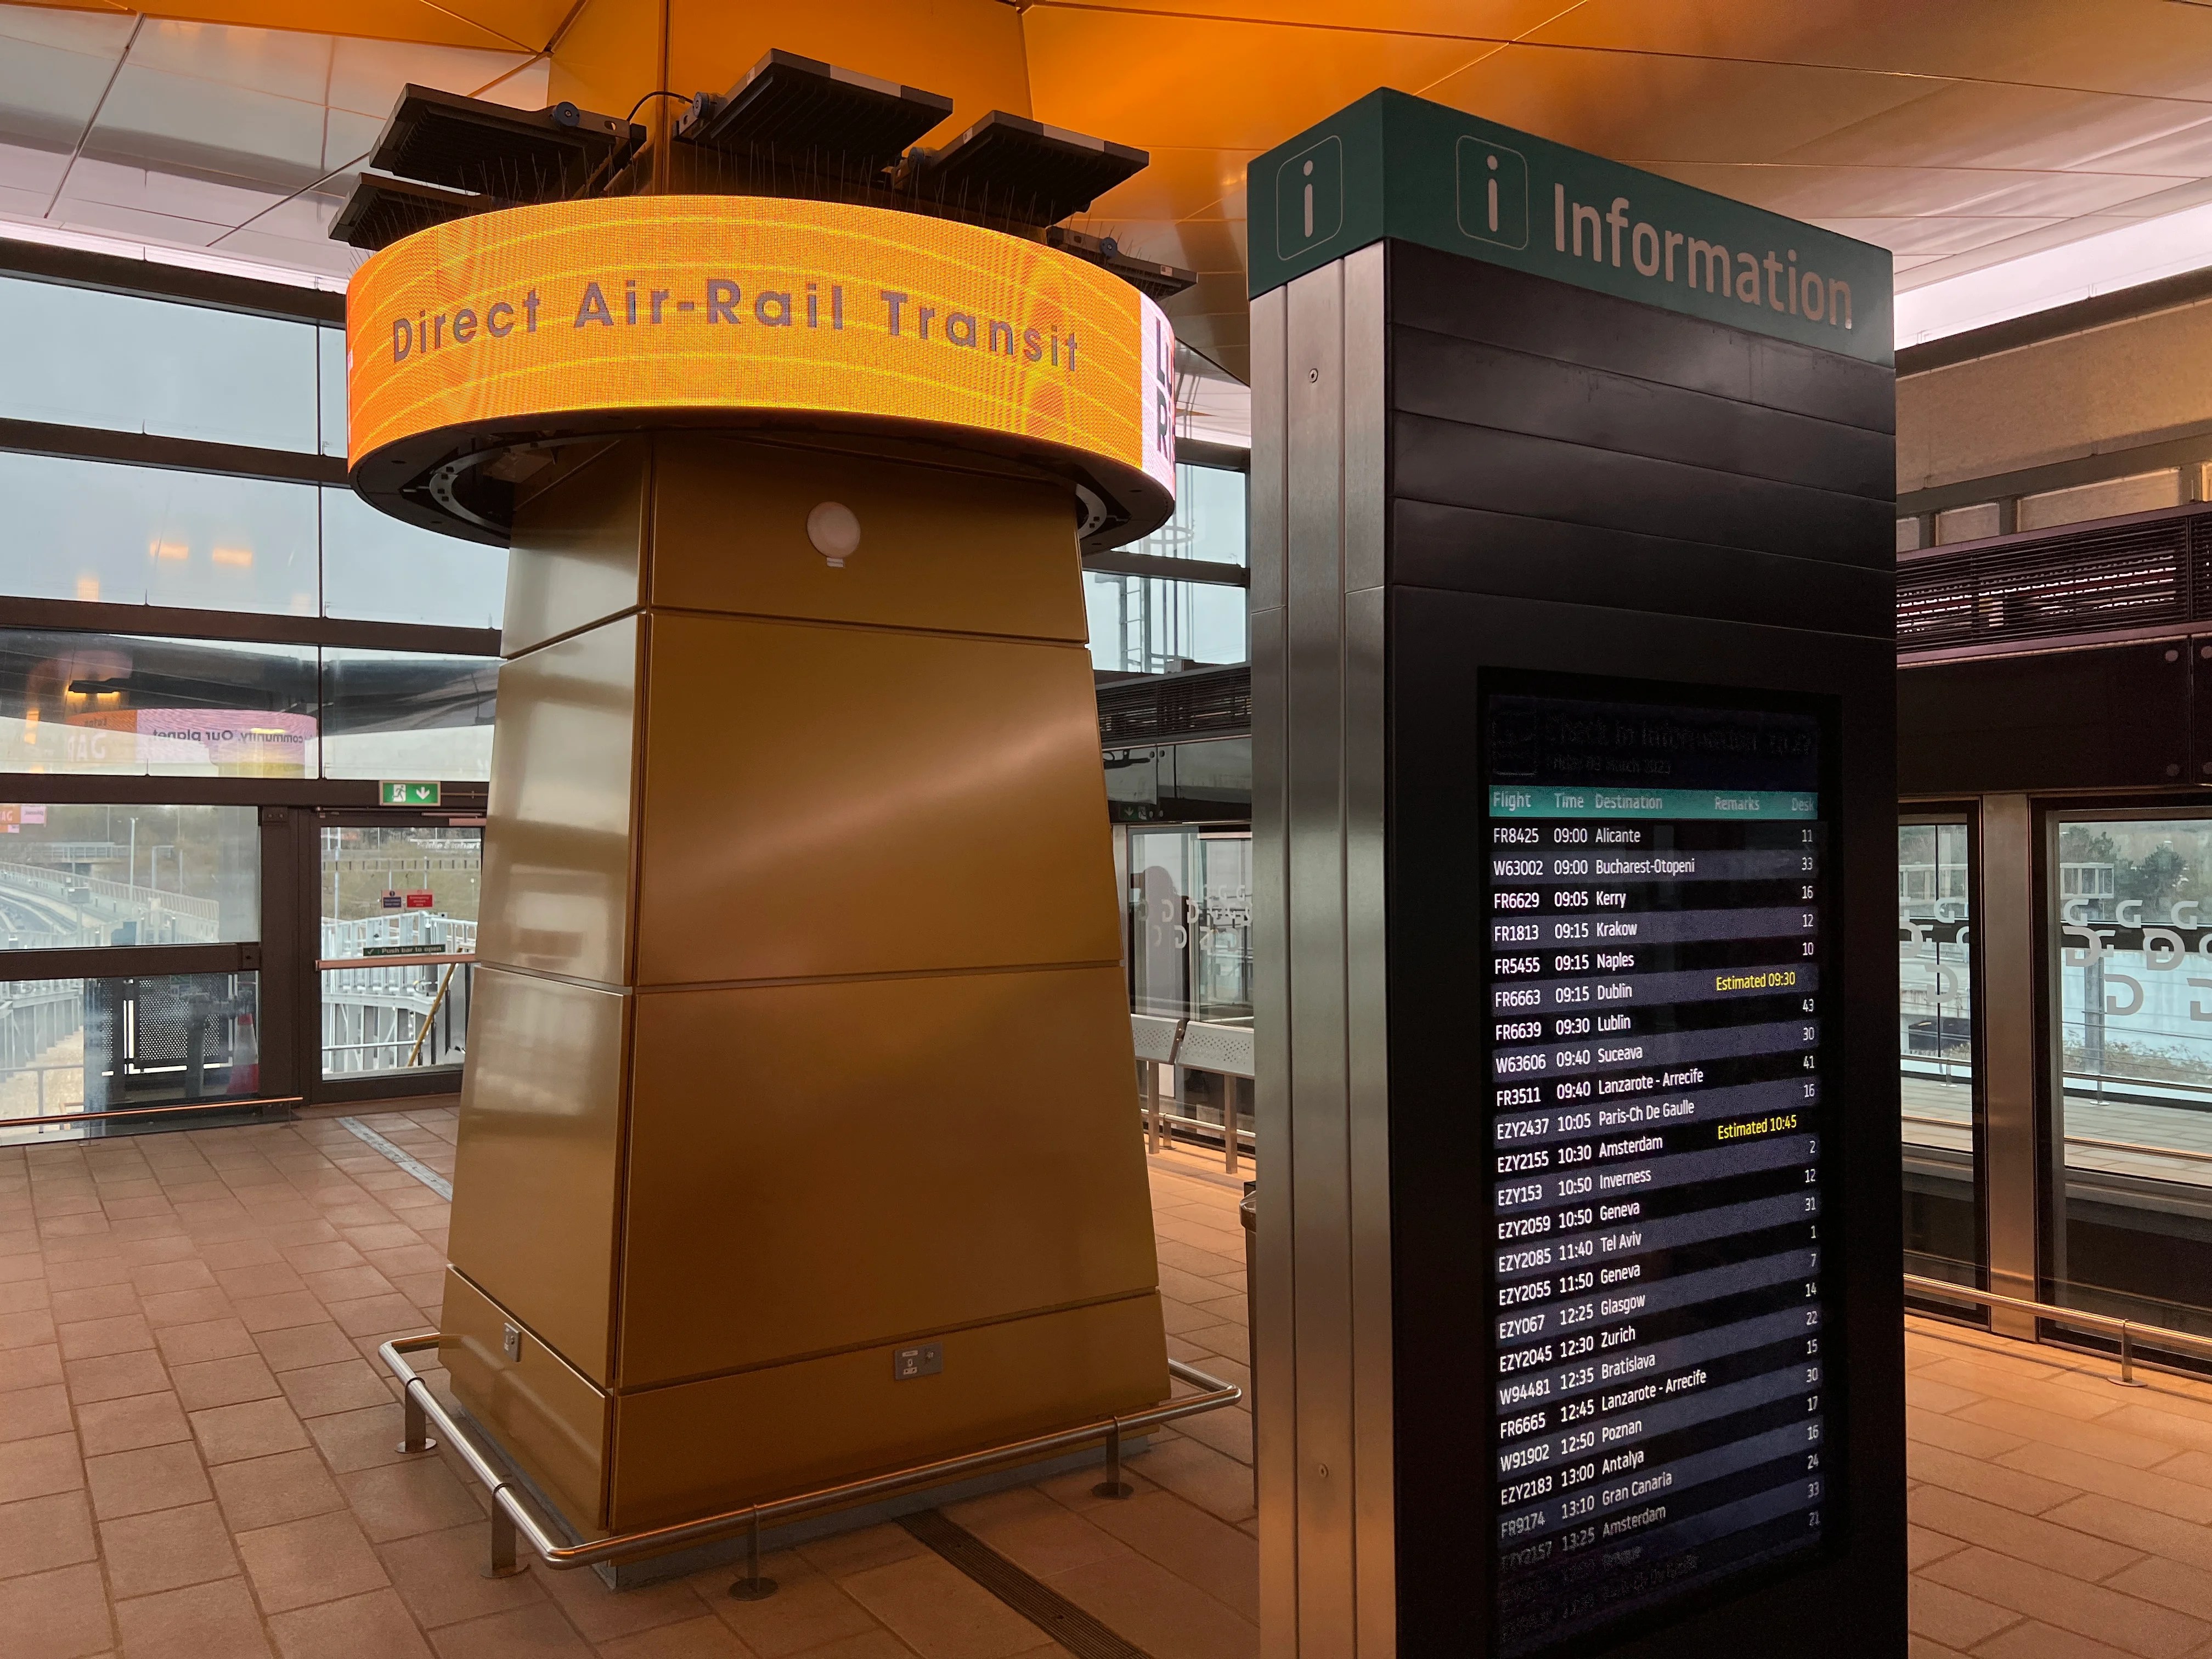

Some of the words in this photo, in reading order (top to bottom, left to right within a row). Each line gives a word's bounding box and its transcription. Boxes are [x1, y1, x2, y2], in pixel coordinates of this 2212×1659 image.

[1553, 182, 1853, 330] Information
[392, 288, 539, 364] Direct
[574, 278, 844, 331] Air-Rail
[881, 290, 1082, 372] Transit
[1493, 791, 1532, 812] Flight
[1553, 792, 1585, 809] Time
[1595, 793, 1663, 810] Destination
[1714, 795, 1760, 811] Remarks
[1791, 797, 1814, 812] Desk
[1493, 860, 1543, 876] W63002
[1554, 860, 1588, 875] 09:00
[1596, 858, 1695, 877] Bucharest-Otopeni
[1802, 856, 1813, 871] 33
[1494, 828, 1539, 843] FR8425
[1554, 828, 1588, 843] 09:00
[1595, 827, 1641, 843] Alicante
[1802, 829, 1813, 842] 11
[1494, 892, 1539, 909] FR6629
[1554, 891, 1588, 907] 09:05
[1596, 891, 1626, 909] Kerry
[1802, 885, 1813, 899] 16
[1494, 924, 1539, 941] FR1813
[1555, 923, 1589, 939] 09:15
[1596, 921, 1638, 937] Krakow
[1802, 913, 1813, 927] 12
[424, 945, 442, 953] open
[1495, 957, 1541, 974] FR5455
[1555, 954, 1589, 971] 09:15
[1597, 951, 1634, 972] Naples
[1802, 942, 1814, 956] 10
[1496, 989, 1541, 1007] FR6663
[1555, 986, 1589, 1003] 09:15
[1597, 983, 1632, 1000] Dublin
[1716, 973, 1766, 991] Estimated
[1768, 972, 1796, 987] 09:30
[1496, 1022, 1542, 1040] FR6639
[1556, 1018, 1590, 1035] 09:30
[1598, 1014, 1631, 1031] Lublin
[1802, 998, 1814, 1012] 43
[1496, 1053, 1546, 1074] W63606
[1556, 1049, 1590, 1067] 09:40
[1598, 1046, 1643, 1063] Suceava
[1803, 1026, 1814, 1041] 30
[1497, 1087, 1541, 1107] FR3511
[1556, 1081, 1591, 1099] 09:40
[1599, 1075, 1654, 1094] Lanzarote
[1662, 1068, 1703, 1087] Arrecife
[1803, 1055, 1815, 1069] 41
[1497, 1118, 1549, 1140] EZY2437
[1558, 1113, 1591, 1132] 10:05
[1599, 1105, 1643, 1126] Paris-Ch
[1646, 1105, 1660, 1120] De
[1663, 1099, 1695, 1118] Gaulle
[1803, 1084, 1815, 1098] 16
[1498, 1150, 1549, 1173] EZY2155
[1558, 1144, 1592, 1164] 10:30
[1599, 1136, 1663, 1158] Amsterdam
[1718, 1118, 1768, 1140] Estimated
[1770, 1114, 1797, 1132] 10:45
[1498, 1184, 1542, 1206] EZY153
[1558, 1176, 1592, 1196] 10:50
[1600, 1170, 1651, 1189] Inverness
[1809, 1140, 1815, 1154] 2
[1498, 1215, 1551, 1239] EZY2059
[1559, 1208, 1592, 1228] 10:50
[1600, 1202, 1640, 1221] Geneva
[1805, 1169, 1816, 1183] 12
[1499, 1248, 1551, 1272] EZY2085
[1559, 1240, 1593, 1261] 11:40
[1600, 1234, 1616, 1252] Tel
[1619, 1231, 1642, 1249] Aviv
[1805, 1197, 1816, 1211] 31
[1499, 1280, 1551, 1306] EZY2055
[1559, 1272, 1593, 1293] 11:50
[1600, 1265, 1640, 1284] Geneva
[1811, 1225, 1816, 1239] 1
[1499, 1314, 1545, 1339] EZY067
[1560, 1304, 1593, 1325] 12:25
[1601, 1295, 1645, 1316] Glasgow
[1811, 1253, 1816, 1267] 7
[1500, 1345, 1552, 1373] EZY2045
[1560, 1335, 1594, 1358] 12:30
[1601, 1325, 1635, 1348] Zurich
[1805, 1282, 1816, 1297] 14
[1499, 1378, 1550, 1405] W94481
[1560, 1367, 1594, 1390] 12:35
[1601, 1354, 1655, 1379] Bratislava
[1806, 1311, 1818, 1325] 22
[1500, 1412, 1545, 1439] FR6665
[1560, 1399, 1594, 1423] 12:45
[1602, 1385, 1656, 1411] Lanzarote
[1665, 1369, 1707, 1393] Arrecife
[1807, 1339, 1818, 1355] 15
[1500, 1443, 1549, 1472] W91902
[1561, 1431, 1594, 1454] 12:50
[1602, 1420, 1642, 1442] Poznan
[1806, 1367, 1818, 1383] 30
[1501, 1475, 1552, 1505] EZY2183
[1561, 1463, 1594, 1487] 13:00
[1602, 1450, 1644, 1475] Antalya
[1807, 1396, 1818, 1412] 17
[1502, 1510, 1545, 1538] FR9174
[1562, 1495, 1594, 1519] 13:10
[1602, 1487, 1629, 1505] Gran
[1632, 1471, 1672, 1497] Canaria
[1807, 1425, 1819, 1440] 16
[1562, 1526, 1595, 1551] 13:25
[1602, 1505, 1666, 1537] Amsterdam
[1808, 1454, 1819, 1470] 24
